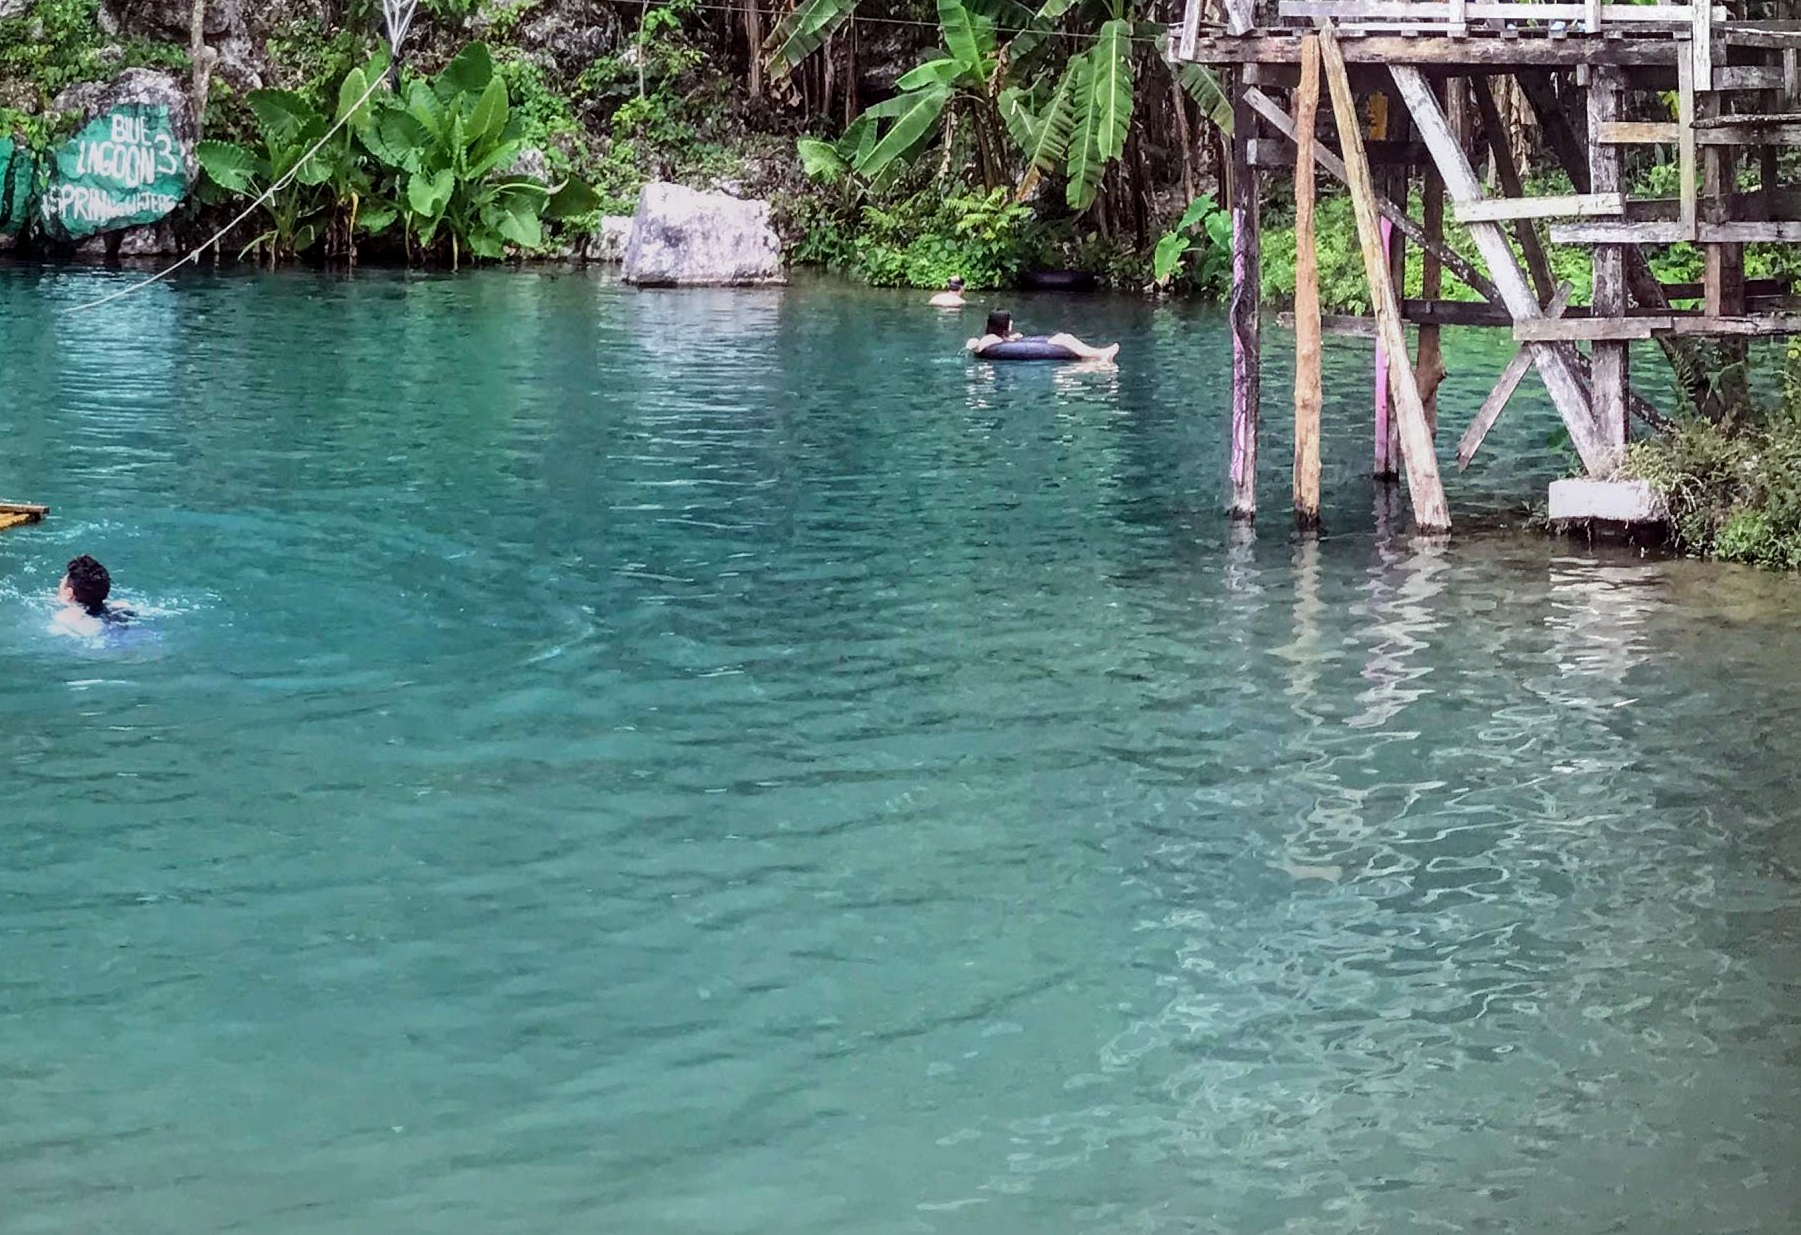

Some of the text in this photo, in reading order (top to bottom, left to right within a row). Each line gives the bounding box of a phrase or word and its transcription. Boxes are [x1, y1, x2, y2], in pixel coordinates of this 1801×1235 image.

[111, 114, 152, 146] BLUE
[76, 134, 178, 188] LAGOON 3
